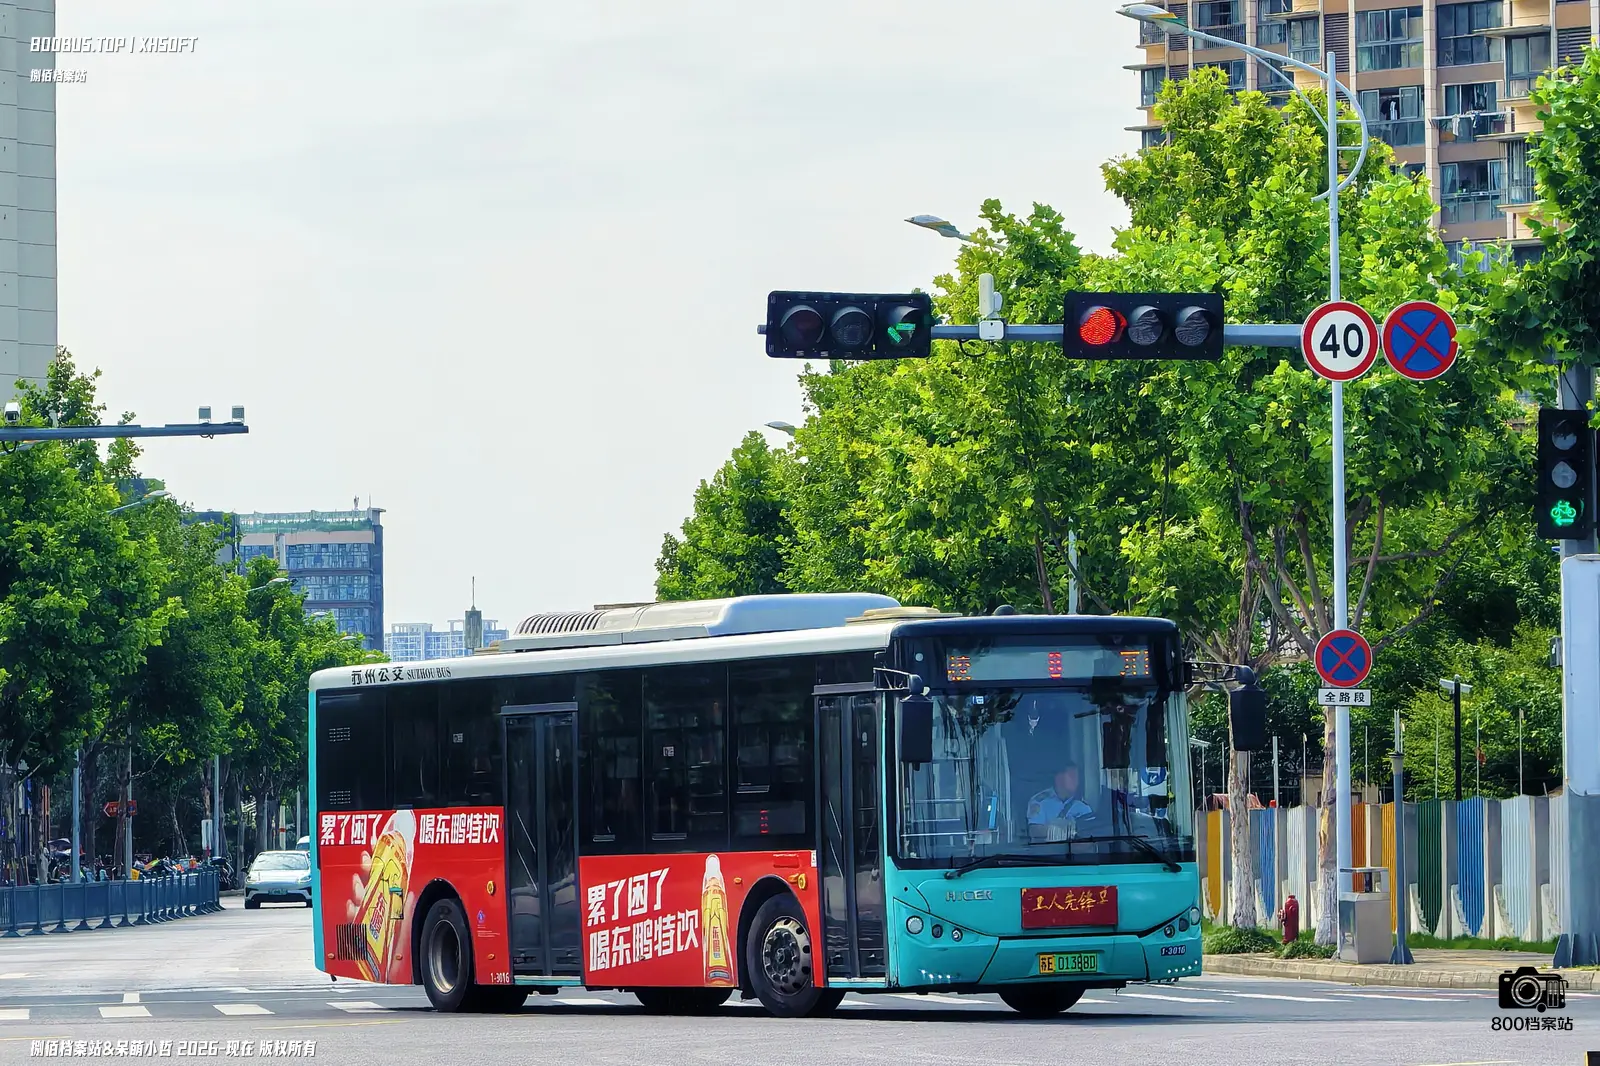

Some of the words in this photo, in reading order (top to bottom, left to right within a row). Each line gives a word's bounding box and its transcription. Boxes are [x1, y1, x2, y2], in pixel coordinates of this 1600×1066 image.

[1320, 323, 1364, 358] 40
[351, 666, 404, 685] 苏州公交
[407, 668, 436, 680] SUZHOU
[436, 667, 452, 678] BUS
[1325, 691, 1364, 703] 全路段
[320, 814, 383, 846] 累了困了
[420, 813, 499, 844] 喝东鹏特饮
[587, 868, 670, 926] 累了困了
[589, 909, 699, 972] 喝东鹏特饮
